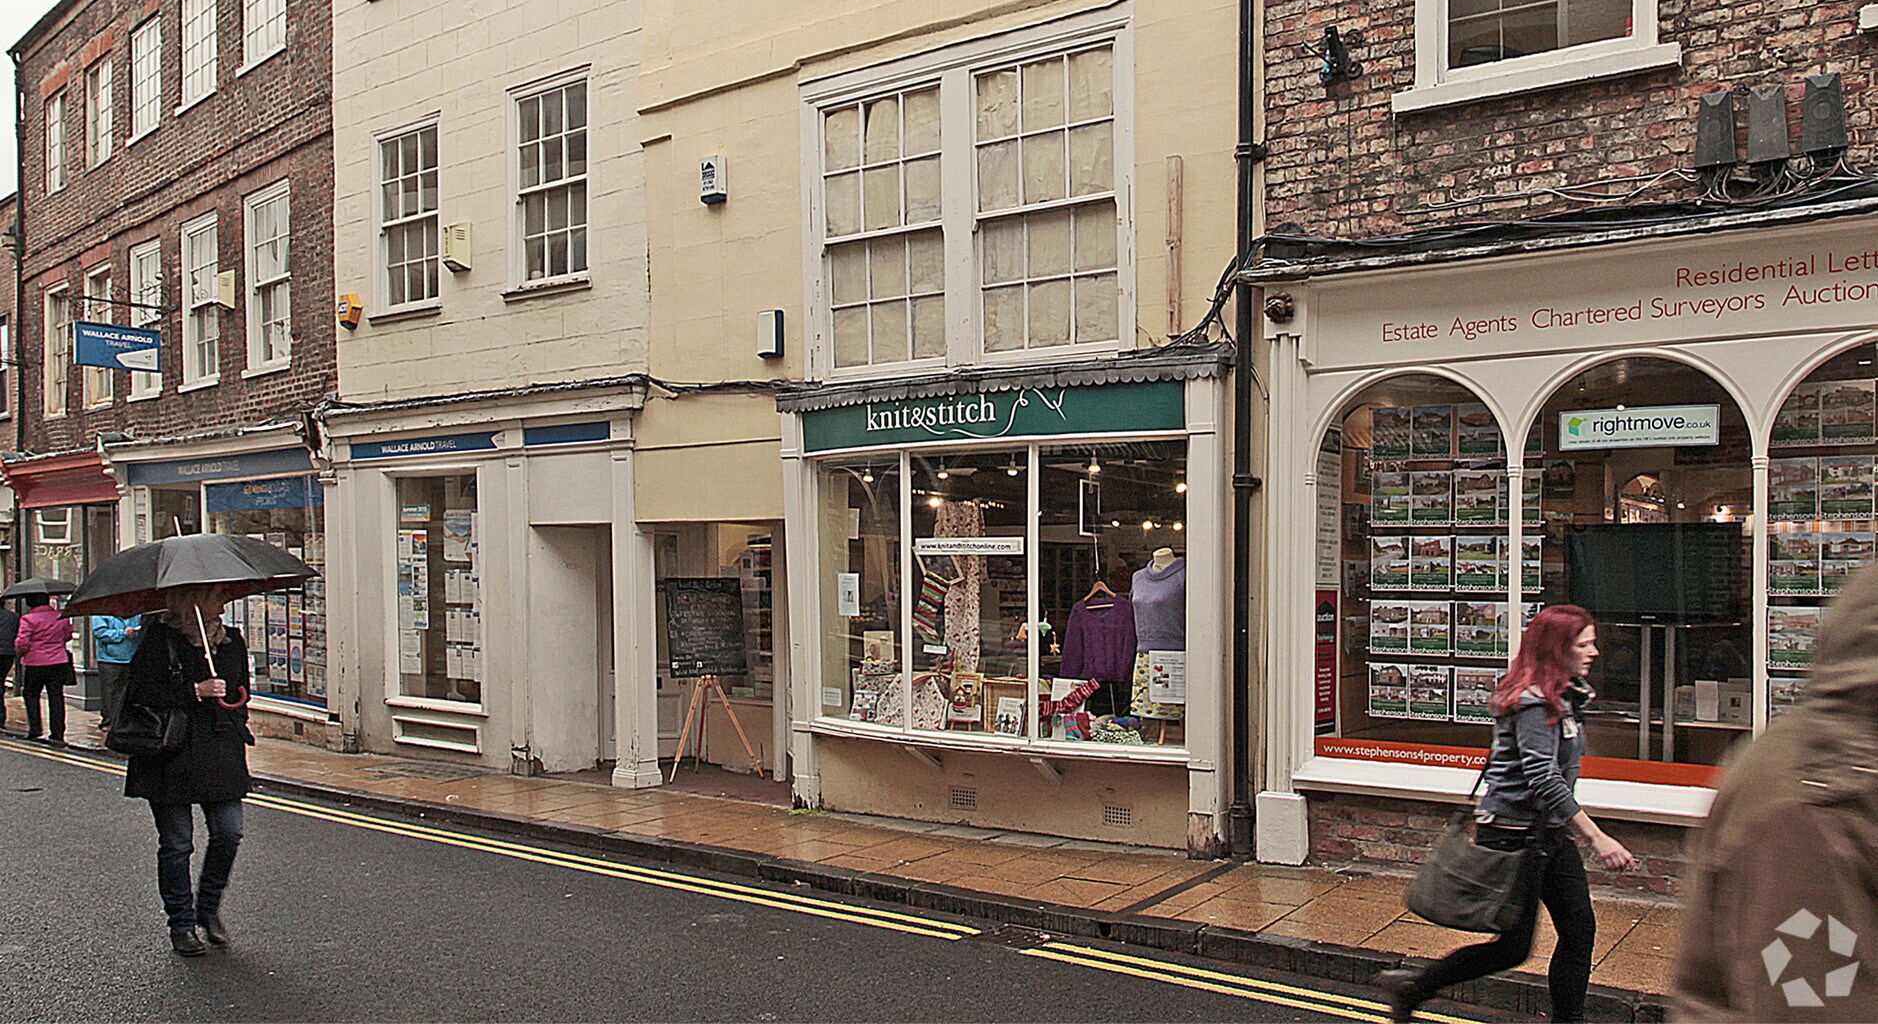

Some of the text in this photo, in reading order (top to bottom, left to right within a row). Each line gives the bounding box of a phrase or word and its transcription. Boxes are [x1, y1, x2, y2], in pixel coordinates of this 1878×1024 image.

[1676, 255, 1815, 288] Residential
[1382, 322, 1438, 342] Estate
[1449, 315, 1517, 340] Agents
[1532, 300, 1642, 329] Chartered
[1651, 293, 1765, 319] Surveyors
[81, 329, 153, 344] WALLACE ARNOLD
[866, 393, 997, 434] knit&stitch
[381, 443, 409, 454] WALLACE
[410, 441, 435, 451] ARNOLD
